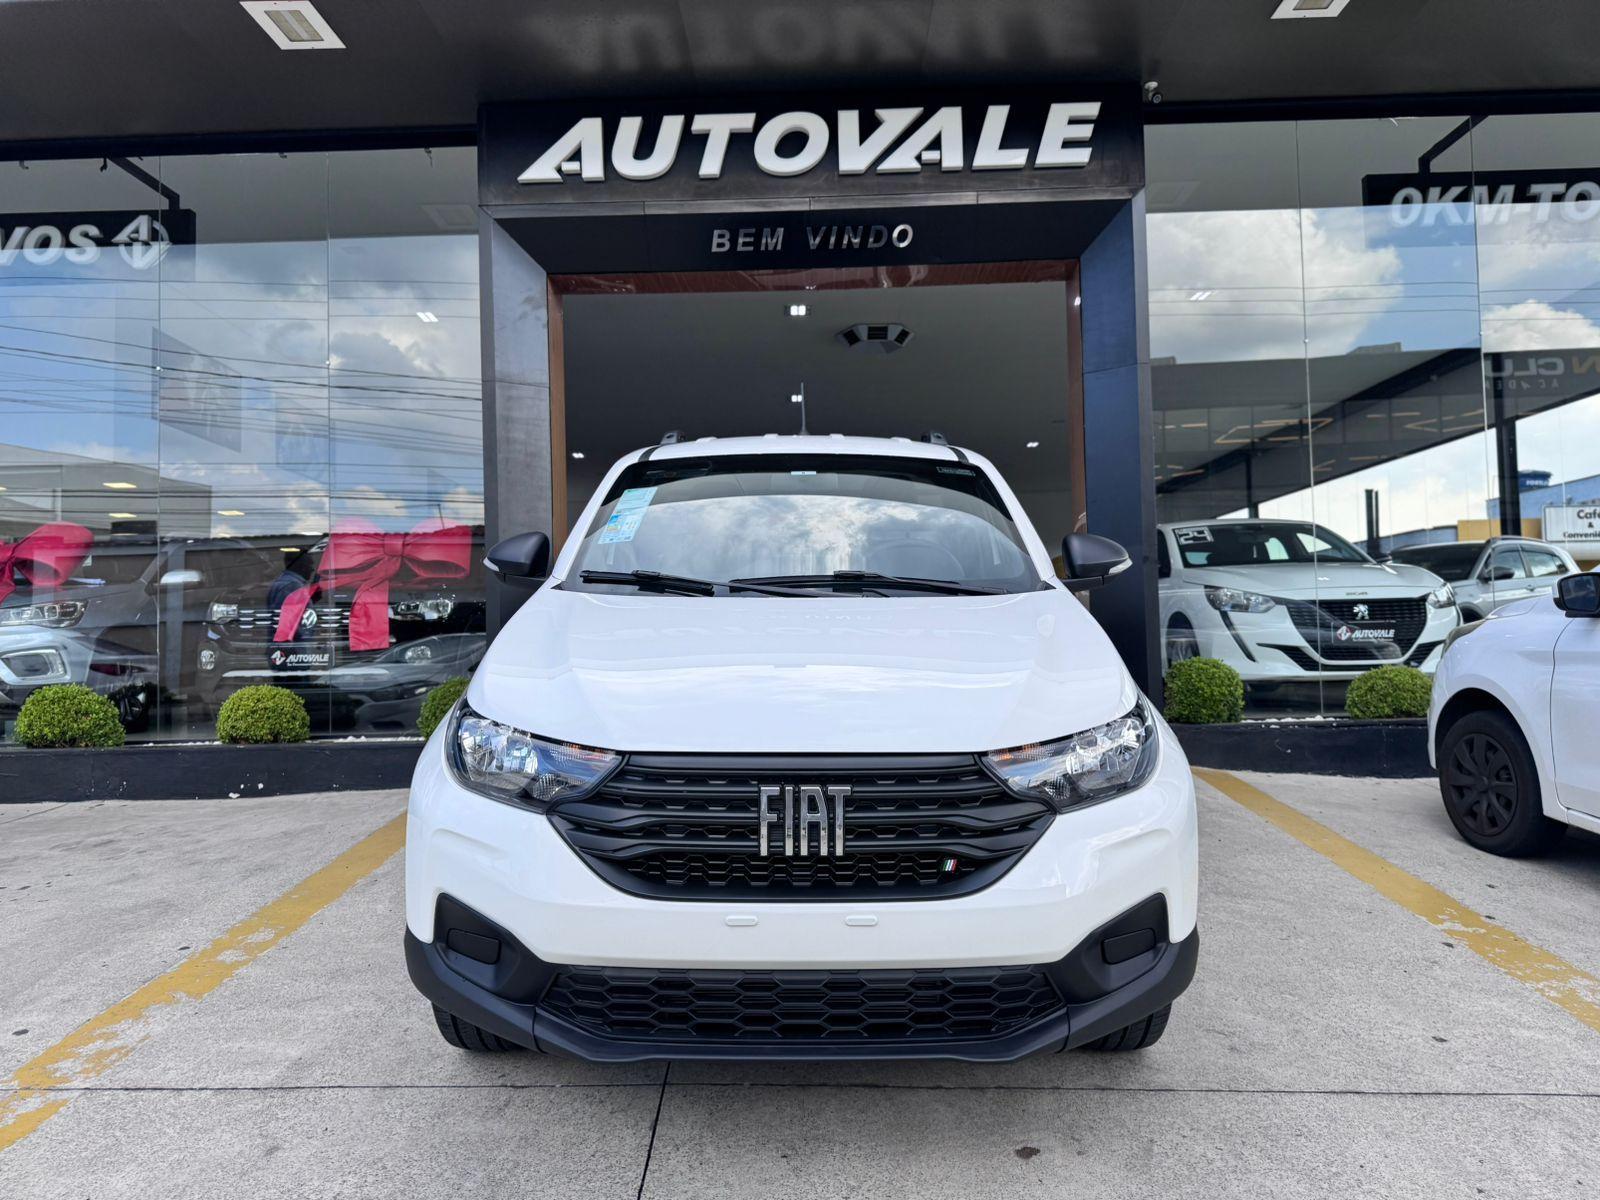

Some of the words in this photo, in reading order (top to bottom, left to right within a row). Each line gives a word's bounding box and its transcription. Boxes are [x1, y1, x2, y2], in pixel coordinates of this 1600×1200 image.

[517, 101, 1102, 184] AUTOVALE
[711, 227, 784, 253] BEM
[806, 224, 914, 249] VINDO
[1352, 629, 1395, 638] AUTOVALE
[286, 654, 330, 662] AUTOVALE
[760, 785, 851, 856] FIAT
